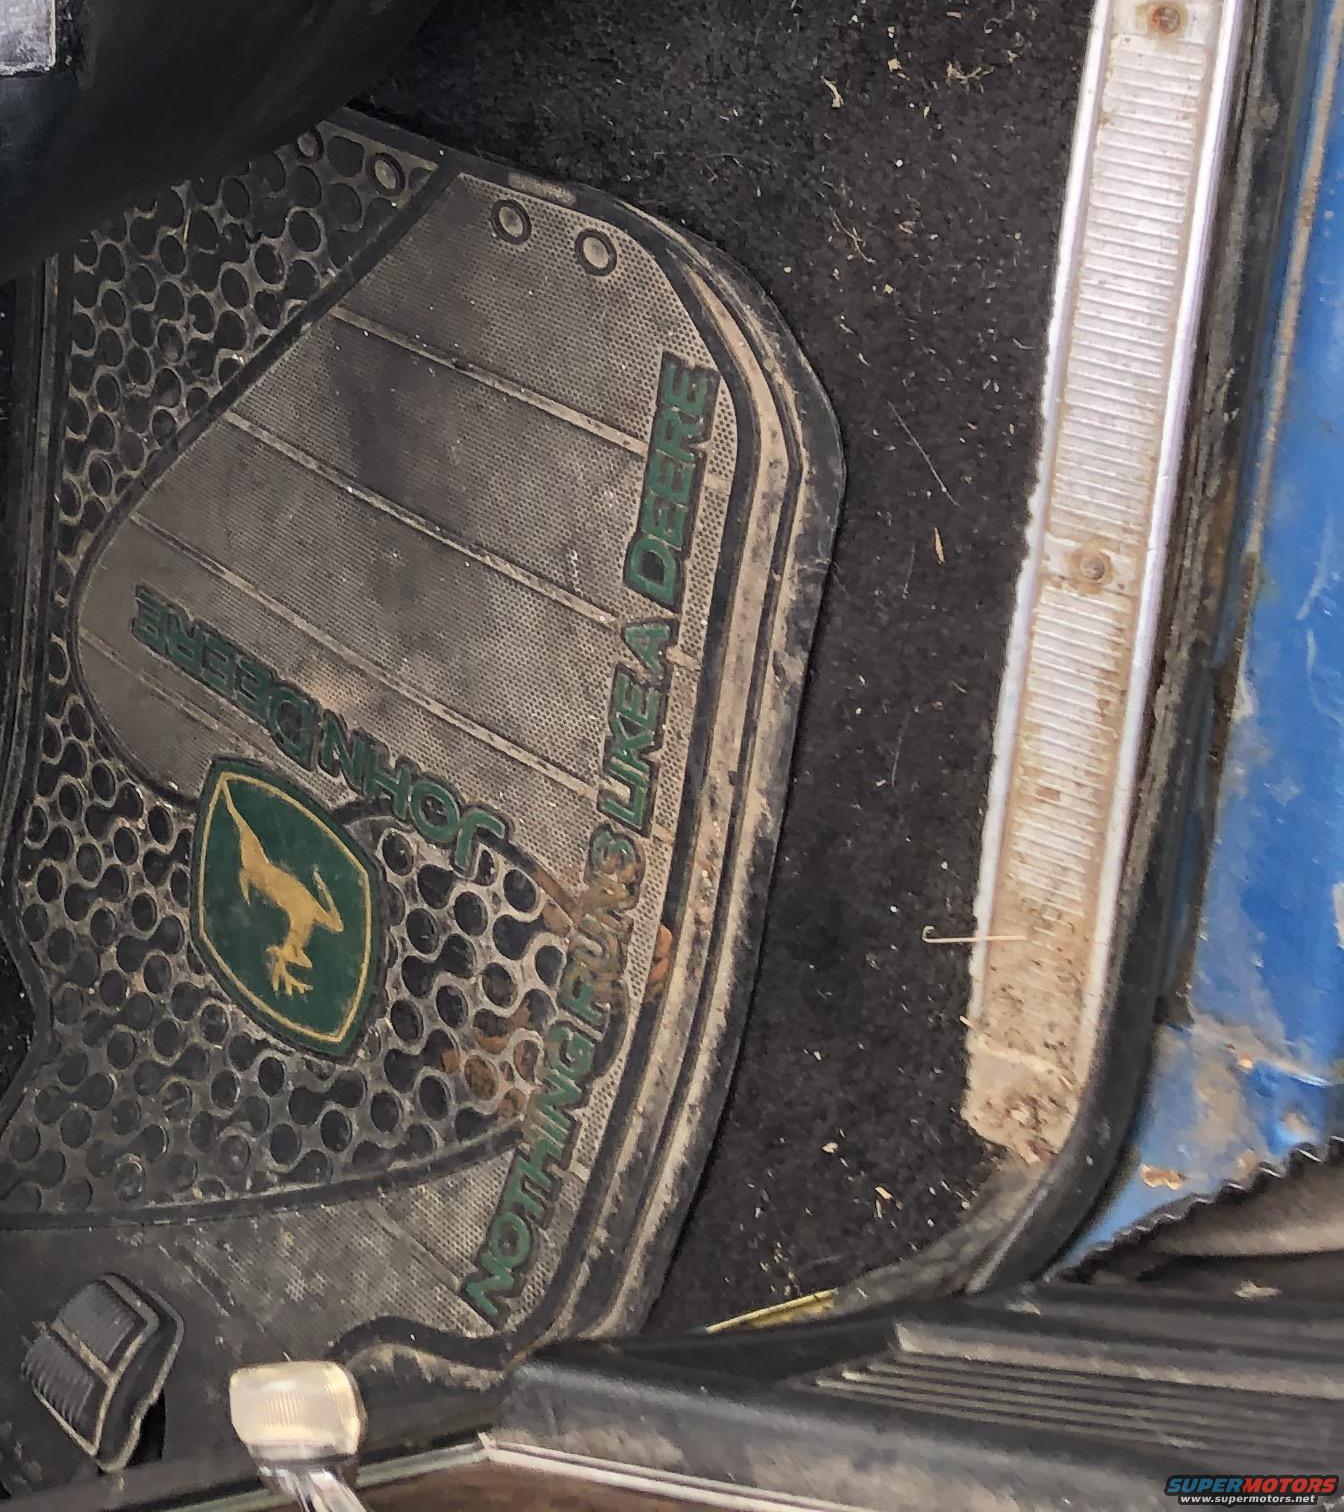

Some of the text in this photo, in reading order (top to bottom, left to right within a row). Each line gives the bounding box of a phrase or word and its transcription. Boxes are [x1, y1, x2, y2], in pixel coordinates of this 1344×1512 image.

[130, 583, 508, 872] JOHN DEERE
[620, 620, 673, 672] A
[599, 667, 661, 830] LIKE
[564, 825, 642, 1028] RUNS
[463, 1024, 596, 1317] NOTHING
